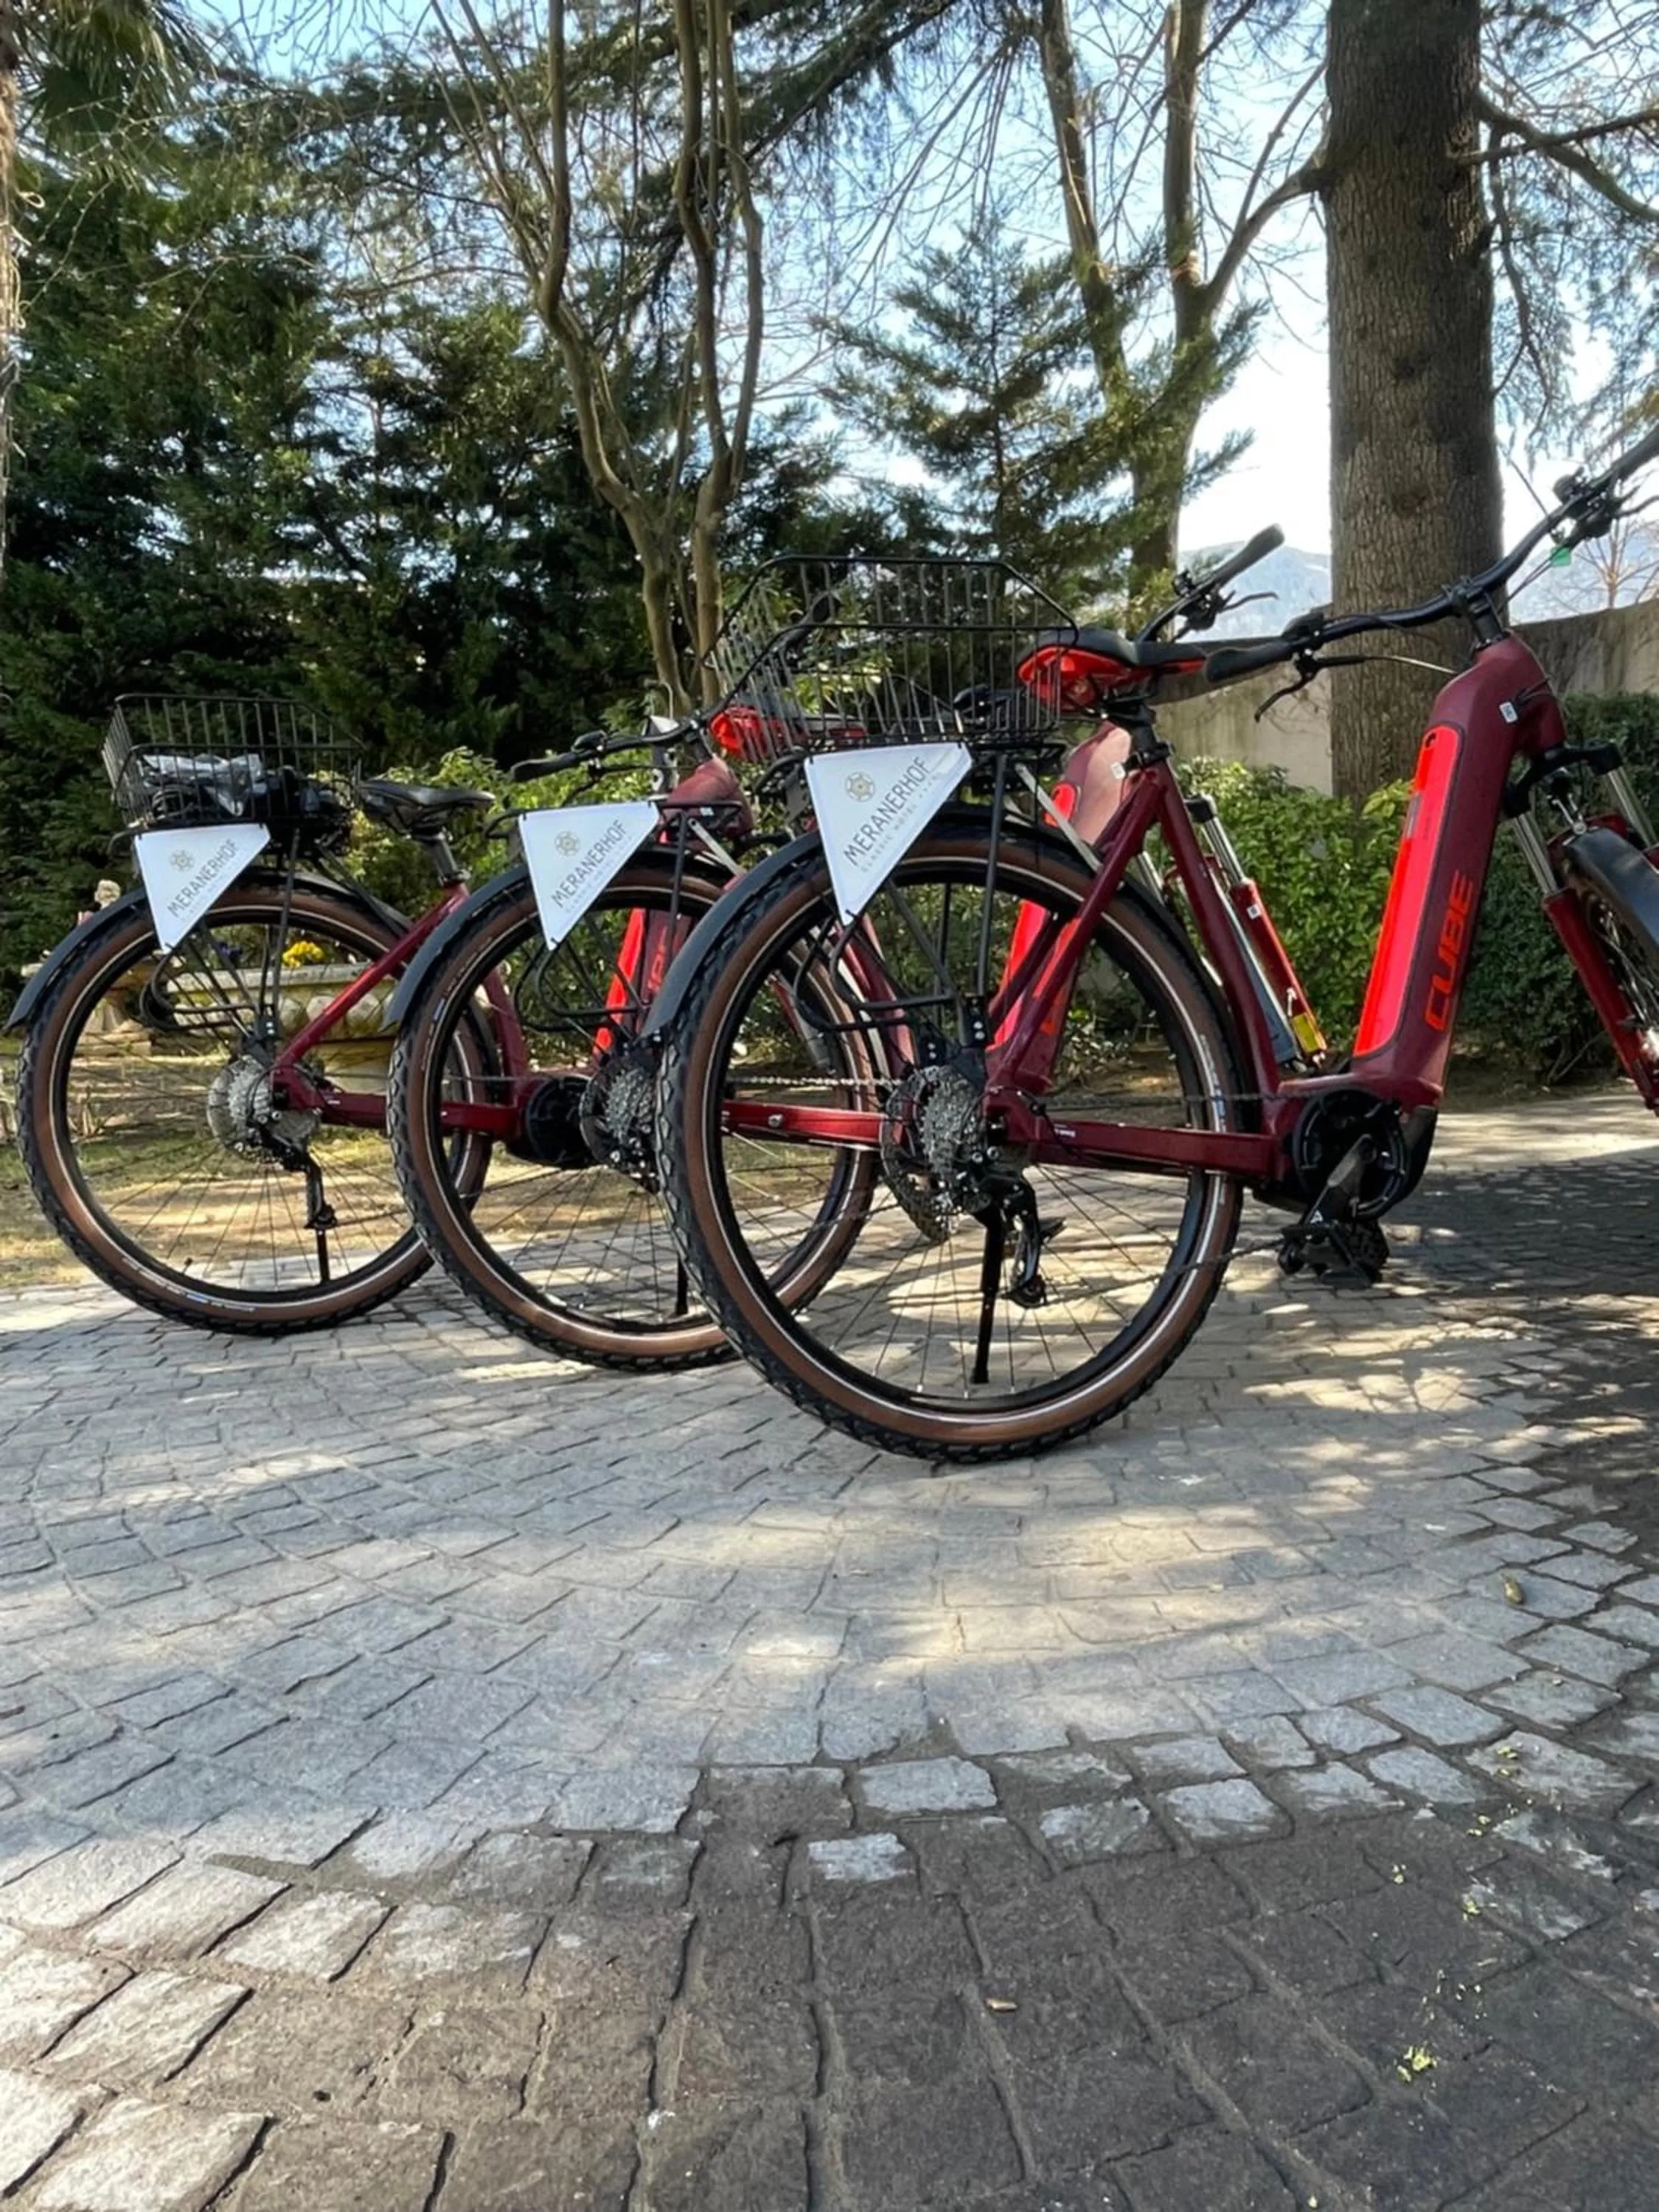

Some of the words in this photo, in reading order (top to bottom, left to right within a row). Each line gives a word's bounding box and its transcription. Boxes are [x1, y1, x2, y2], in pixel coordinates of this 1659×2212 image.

[843, 756, 931, 866] MERANERHOF
[167, 838, 237, 918] MERANERHOF
[551, 819, 627, 908] MERANERHOF
[1424, 869, 1474, 1031] CUBE
